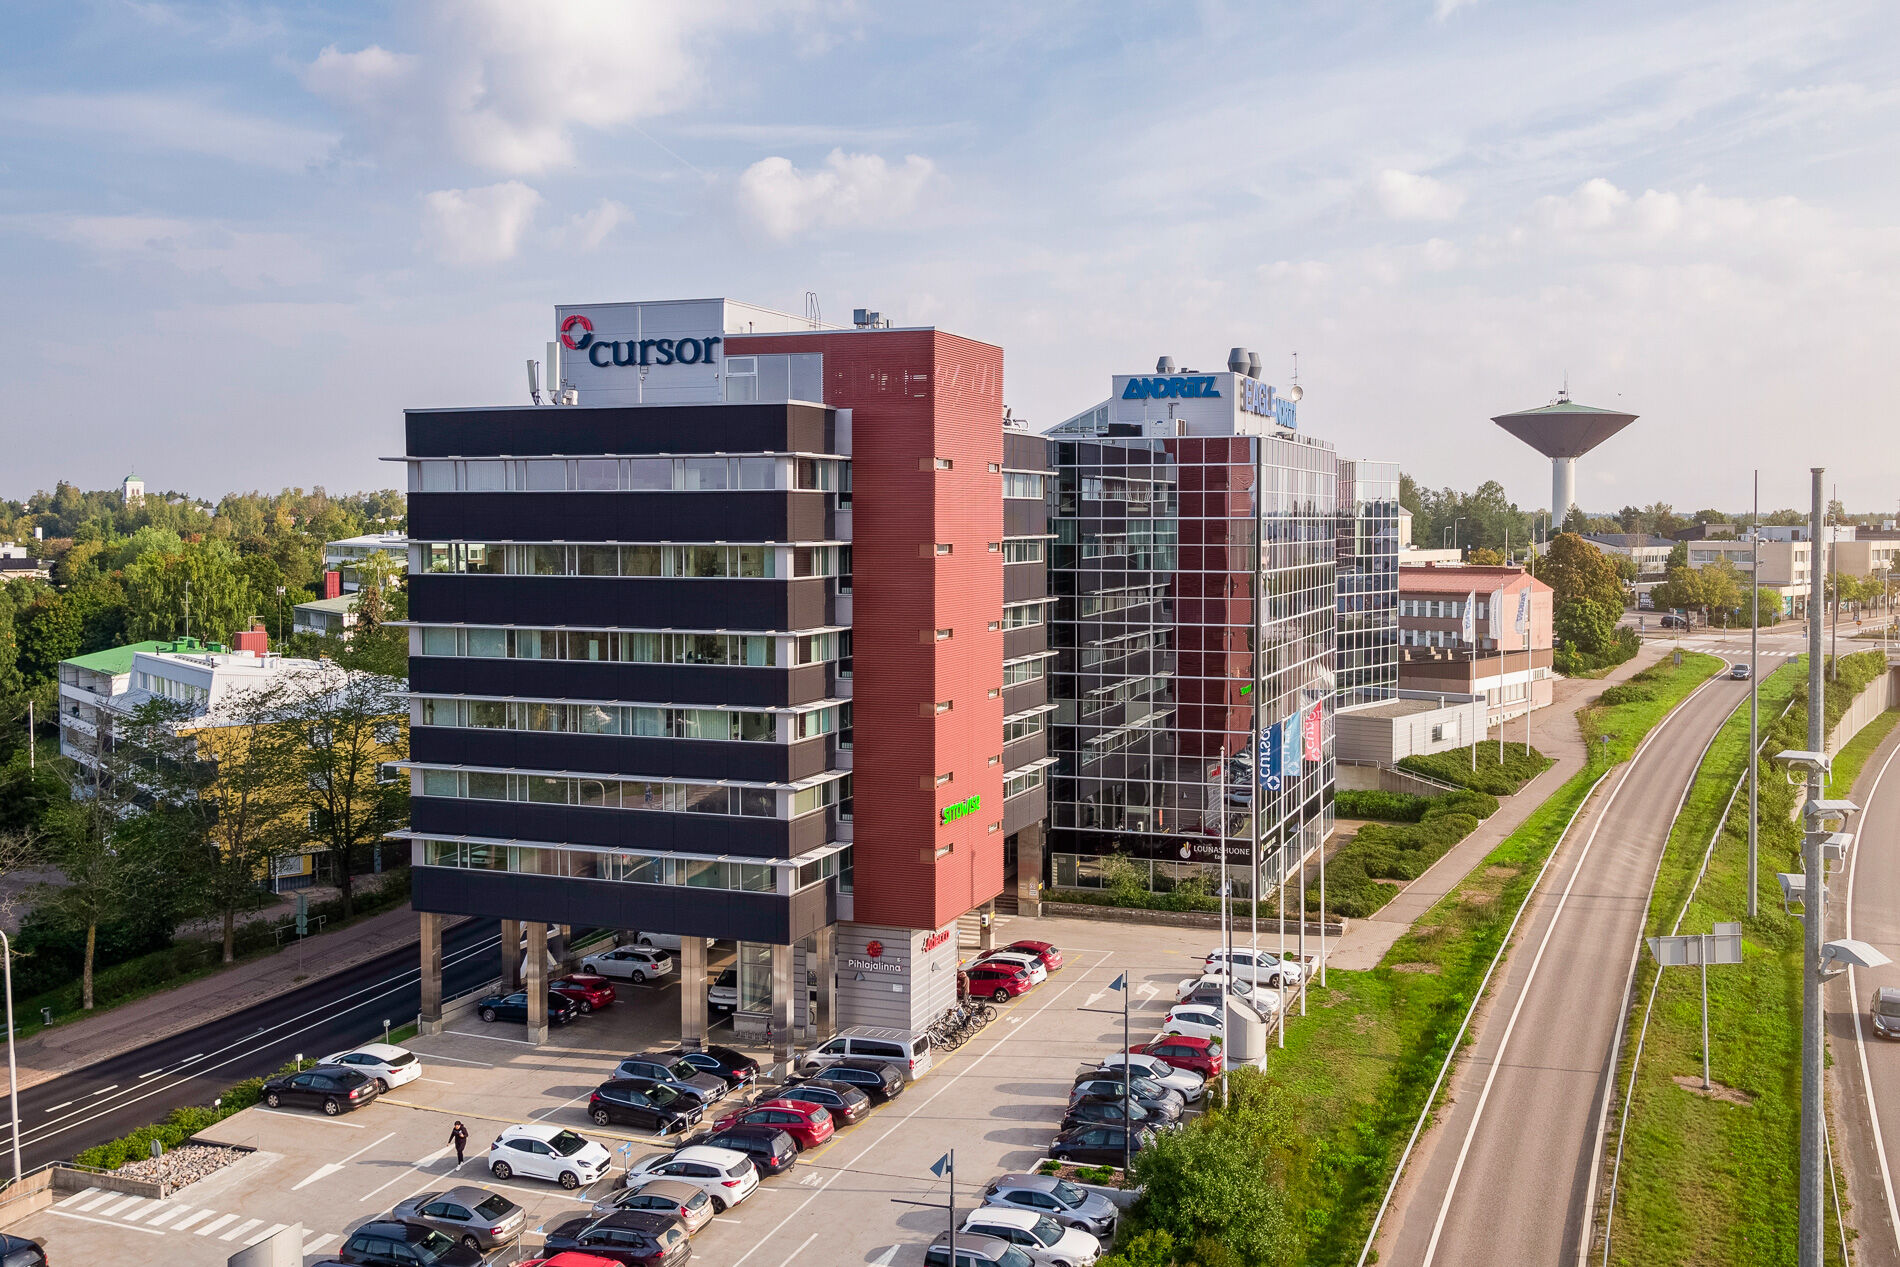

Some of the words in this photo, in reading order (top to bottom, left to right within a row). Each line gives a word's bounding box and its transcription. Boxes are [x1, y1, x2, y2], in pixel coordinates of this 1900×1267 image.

[588, 336, 722, 367] cursor
[1122, 376, 1220, 399] ANDRITZ
[1244, 377, 1276, 417] EAGLE
[1276, 398, 1297, 429] NDRITZ
[848, 959, 902, 972] Pihlajalinna
